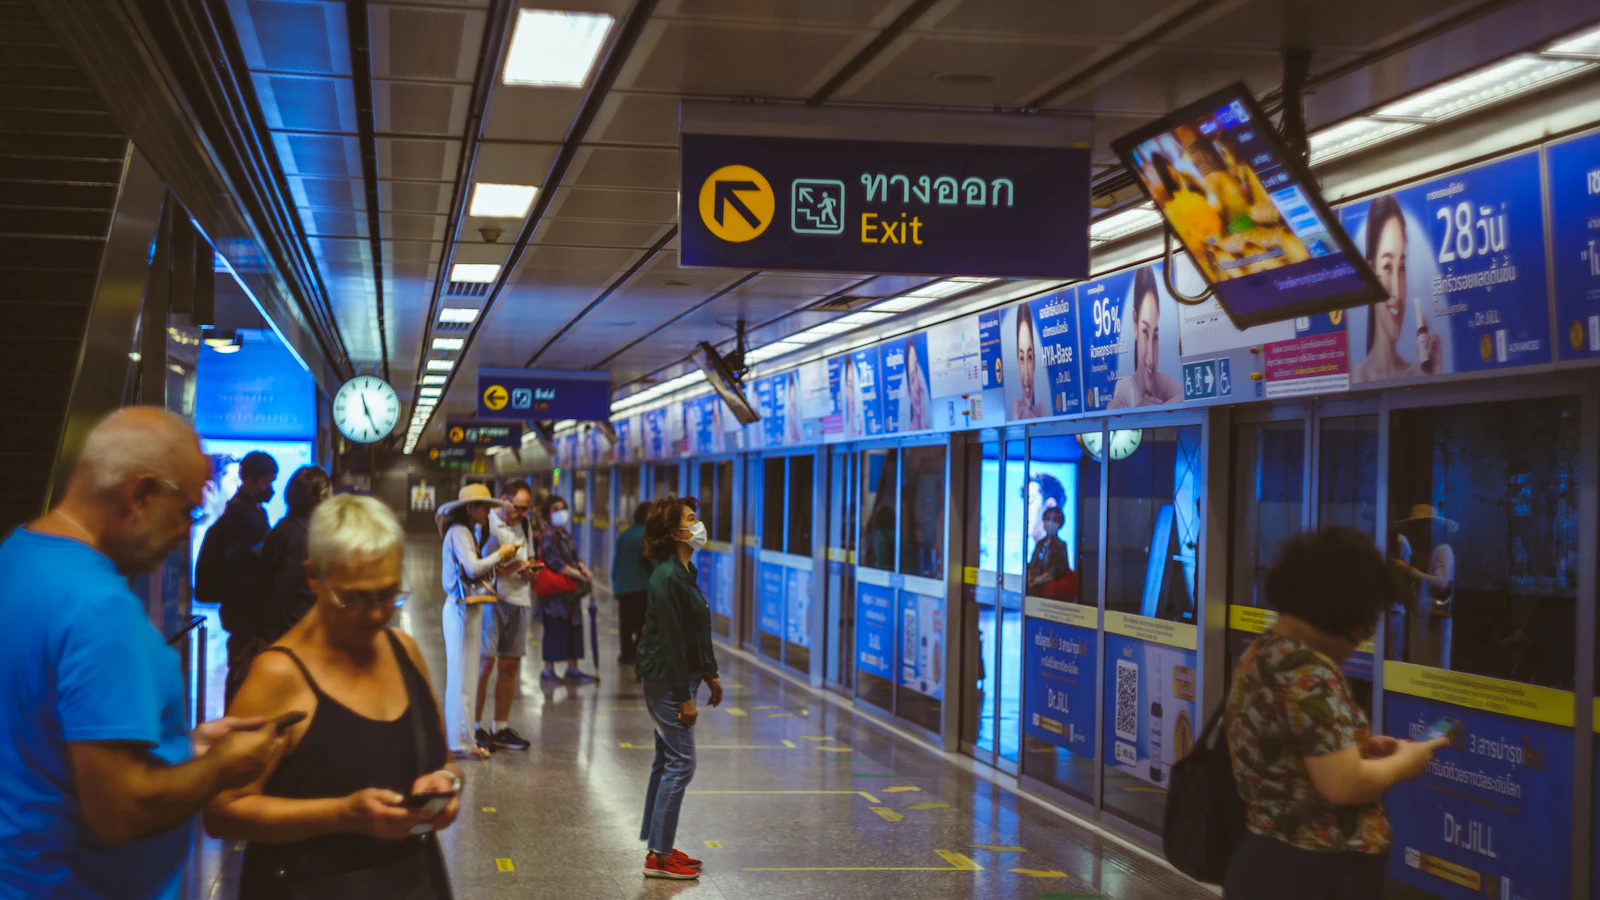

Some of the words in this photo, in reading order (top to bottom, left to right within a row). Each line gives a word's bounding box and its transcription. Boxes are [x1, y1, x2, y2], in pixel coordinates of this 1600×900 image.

[860, 173, 1014, 206] ทางออก
[861, 212, 923, 245] Exit
[1093, 297, 1121, 338] 96%
[1041, 343, 1073, 366] HYA-Base
